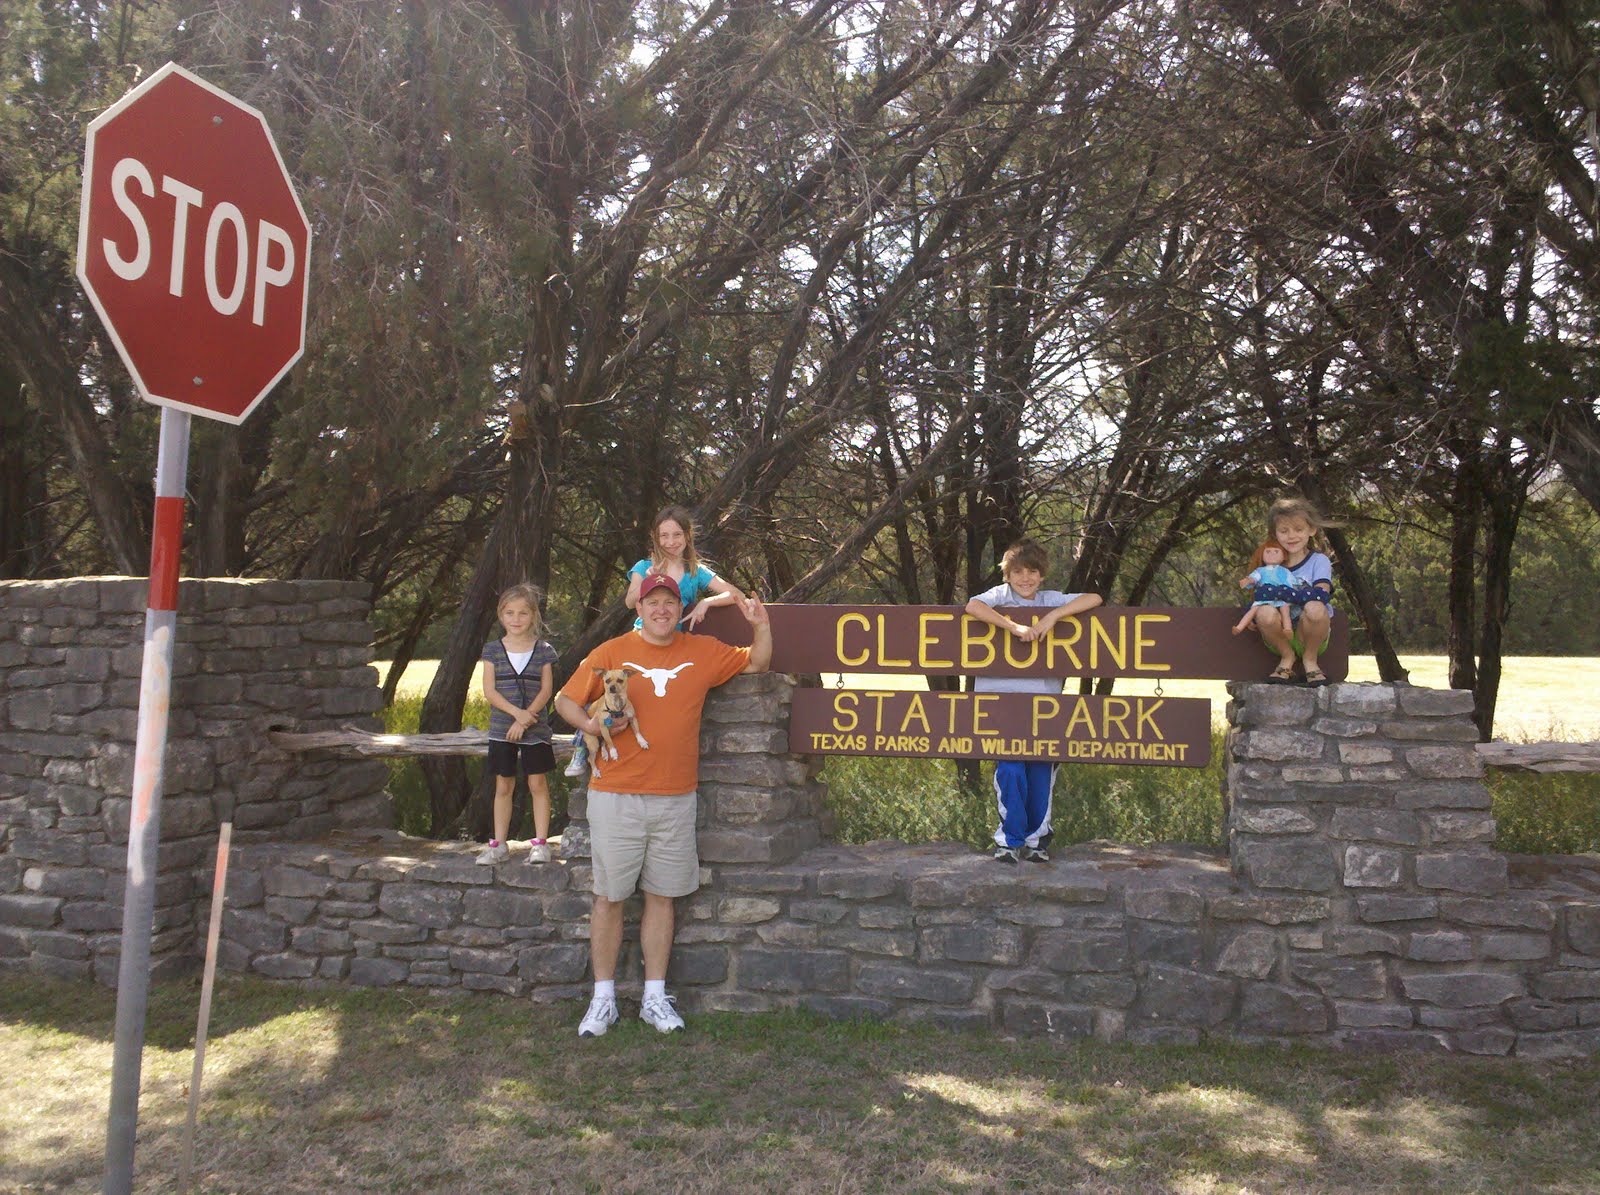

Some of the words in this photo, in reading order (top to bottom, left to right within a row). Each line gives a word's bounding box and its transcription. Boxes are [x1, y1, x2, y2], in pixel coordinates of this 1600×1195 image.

[103, 158, 294, 326] STOP
[836, 612, 1171, 671] CLEBURNE
[832, 691, 1000, 735] STATE
[1032, 695, 1164, 740] PARK
[810, 733, 867, 750] TEXAS
[874, 735, 930, 752] PARKS
[938, 737, 973, 754] AND
[981, 738, 1060, 757] WILDLIFE
[1068, 740, 1189, 761] DEPARTMENT
